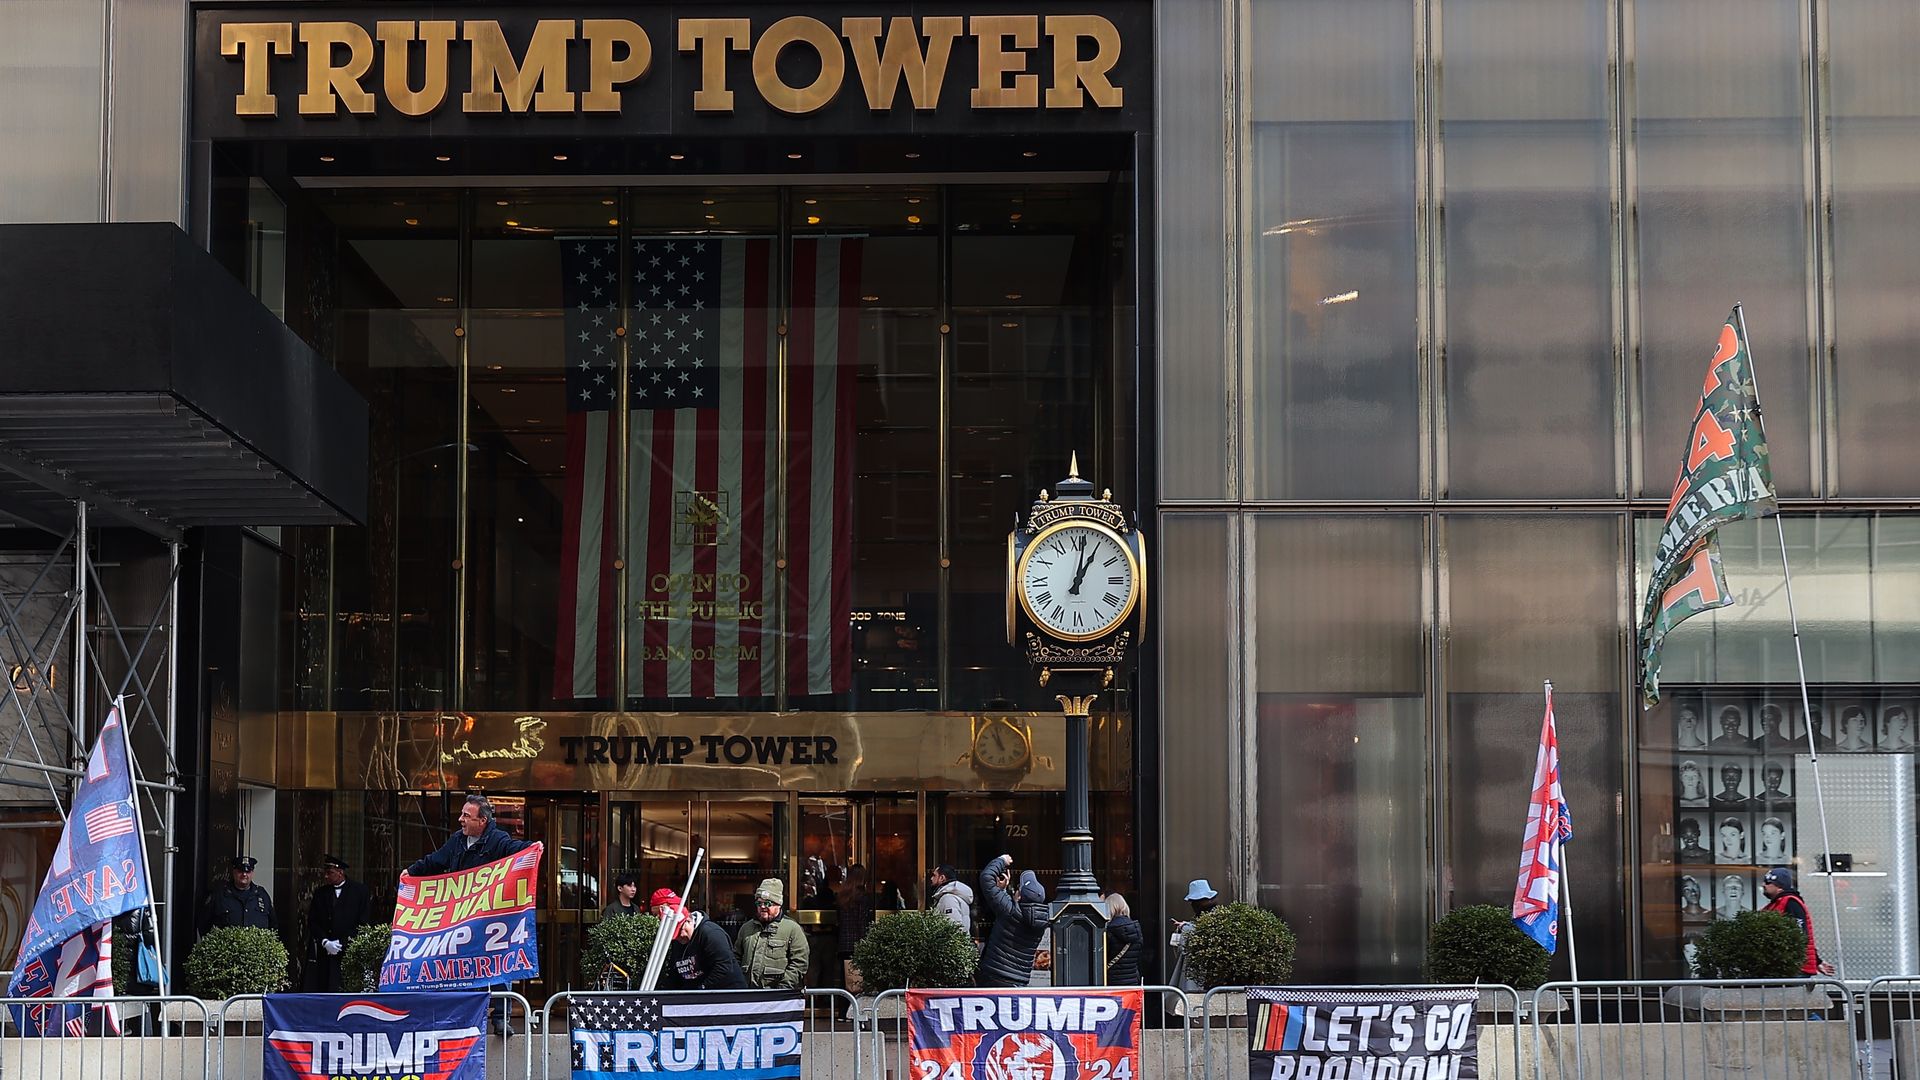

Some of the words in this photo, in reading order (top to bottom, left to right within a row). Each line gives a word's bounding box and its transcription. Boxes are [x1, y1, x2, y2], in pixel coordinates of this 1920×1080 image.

[220, 19, 653, 118] TRUMP
[677, 14, 1124, 115] TOWER
[1039, 506, 1075, 524] TRUMP
[1079, 506, 1116, 524] TOWER
[651, 573, 715, 593] OPEN
[717, 573, 750, 593] TO
[636, 600, 679, 620] THE
[686, 600, 767, 620] PUBLIC
[877, 612, 906, 620] ZONE
[559, 735, 694, 765] TRUMP
[700, 734, 838, 765] TOWER
[1005, 824, 1028, 837] 725
[416, 857, 514, 905] FINISH
[451, 879, 533, 924] WALL
[384, 926, 472, 963] RUMP
[485, 917, 529, 952] 24
[416, 947, 534, 984] AMERICA
[929, 997, 1120, 1032] TRUMP
[1302, 1004, 1416, 1052] LET'S
[1424, 1003, 1473, 1051] GO
[268, 1027, 481, 1075] TRUMP
[572, 1026, 798, 1073] TRUMP
